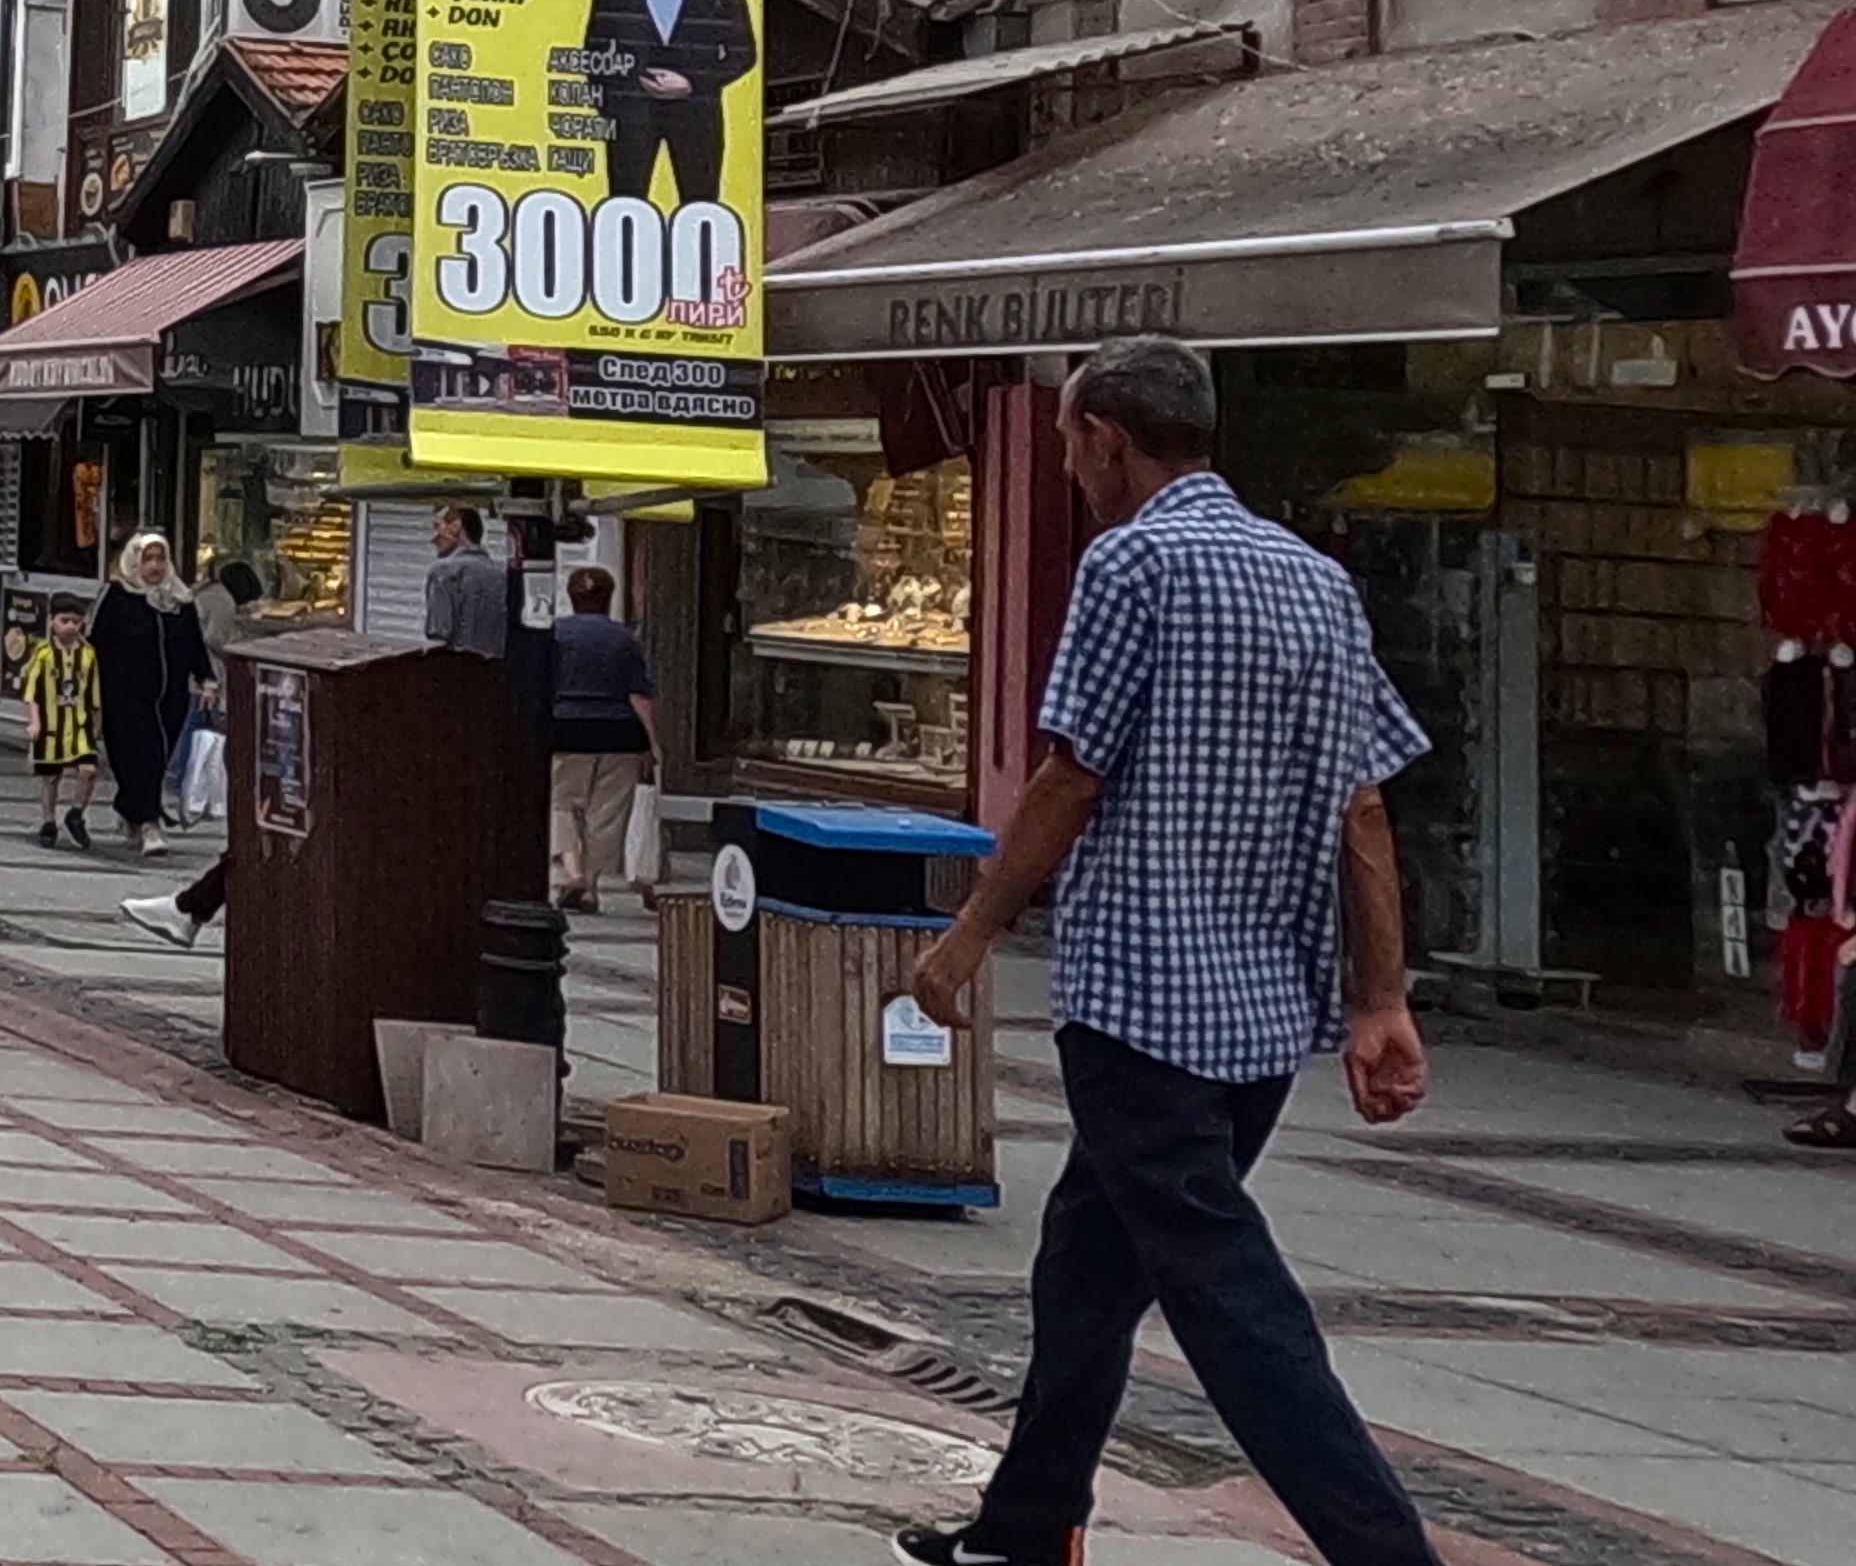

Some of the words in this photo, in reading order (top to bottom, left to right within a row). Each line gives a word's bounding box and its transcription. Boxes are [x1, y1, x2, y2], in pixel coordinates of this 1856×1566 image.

[447, 5, 502, 28] DON
[437, 183, 745, 322] 3000
[888, 293, 991, 346] RENK
[1783, 303, 1856, 351] AY
[599, 356, 671, 386] След
[673, 360, 725, 388] 300
[655, 391, 755, 420] вдясно
